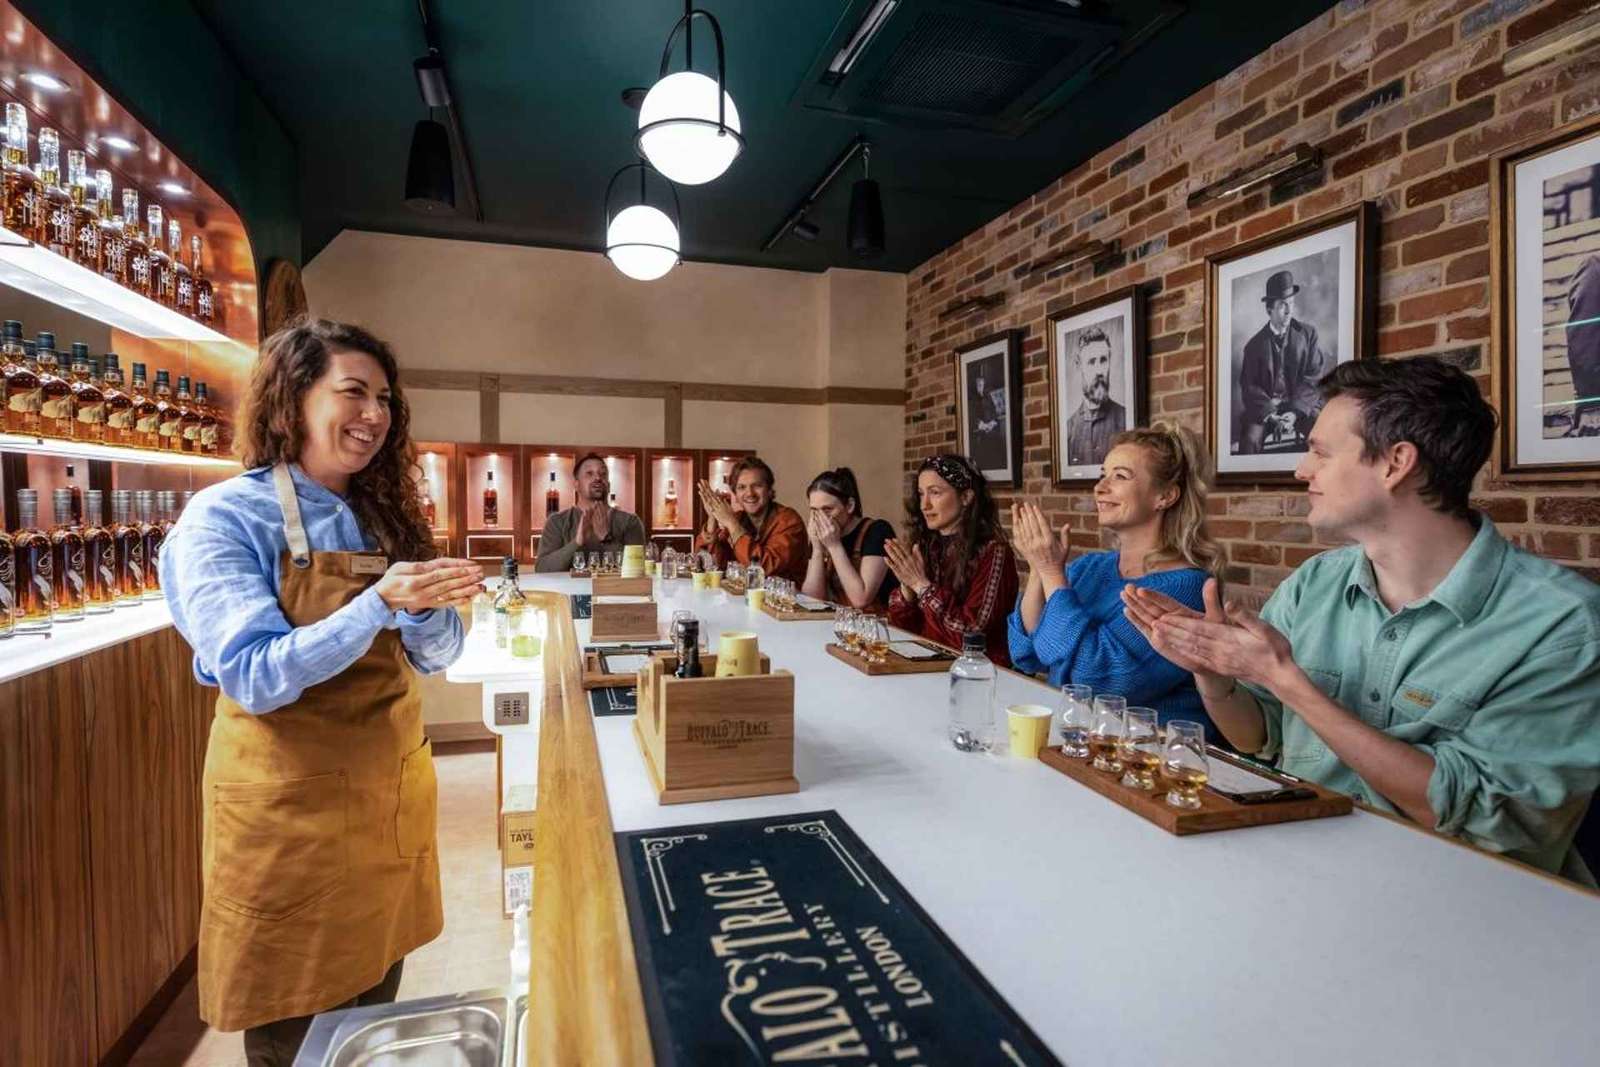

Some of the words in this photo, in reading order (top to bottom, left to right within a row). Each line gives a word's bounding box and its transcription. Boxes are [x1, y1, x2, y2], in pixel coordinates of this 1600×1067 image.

[511, 831, 534, 843] TAYL
[701, 866, 811, 957] TRACE
[804, 903, 927, 1067] ISTILLERY
[856, 926, 934, 1008] LONDON
[750, 986, 869, 1067] ALO
